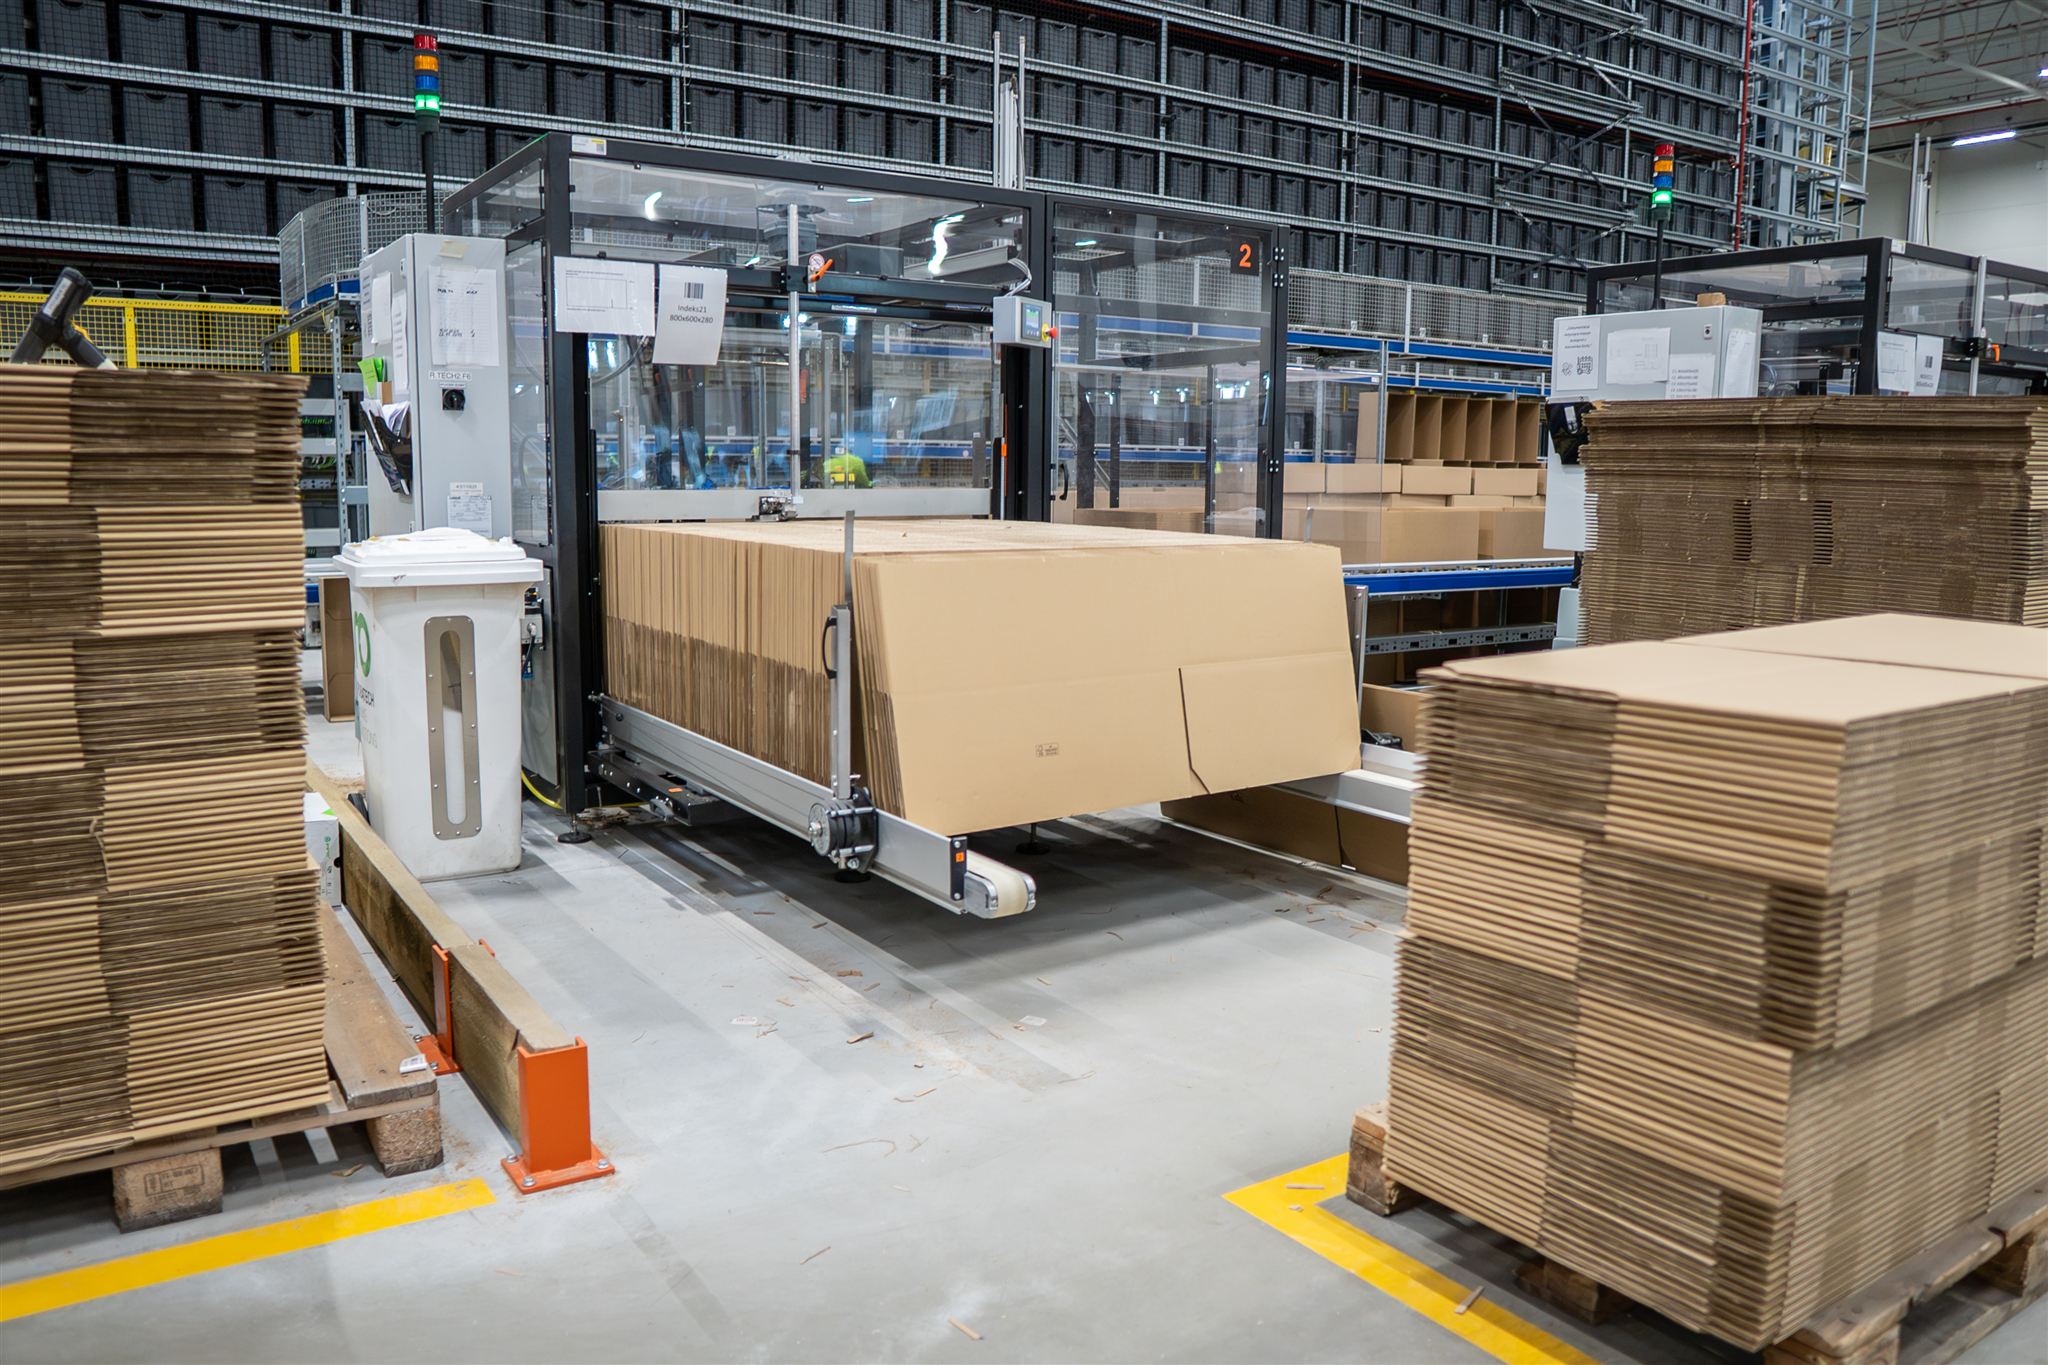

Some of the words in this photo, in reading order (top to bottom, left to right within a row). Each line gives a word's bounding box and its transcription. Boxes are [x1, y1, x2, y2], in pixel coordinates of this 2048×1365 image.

[1239, 243, 1252, 268] 2
[678, 305, 707, 313] Indeks21
[670, 314, 714, 324] 800x600x280
